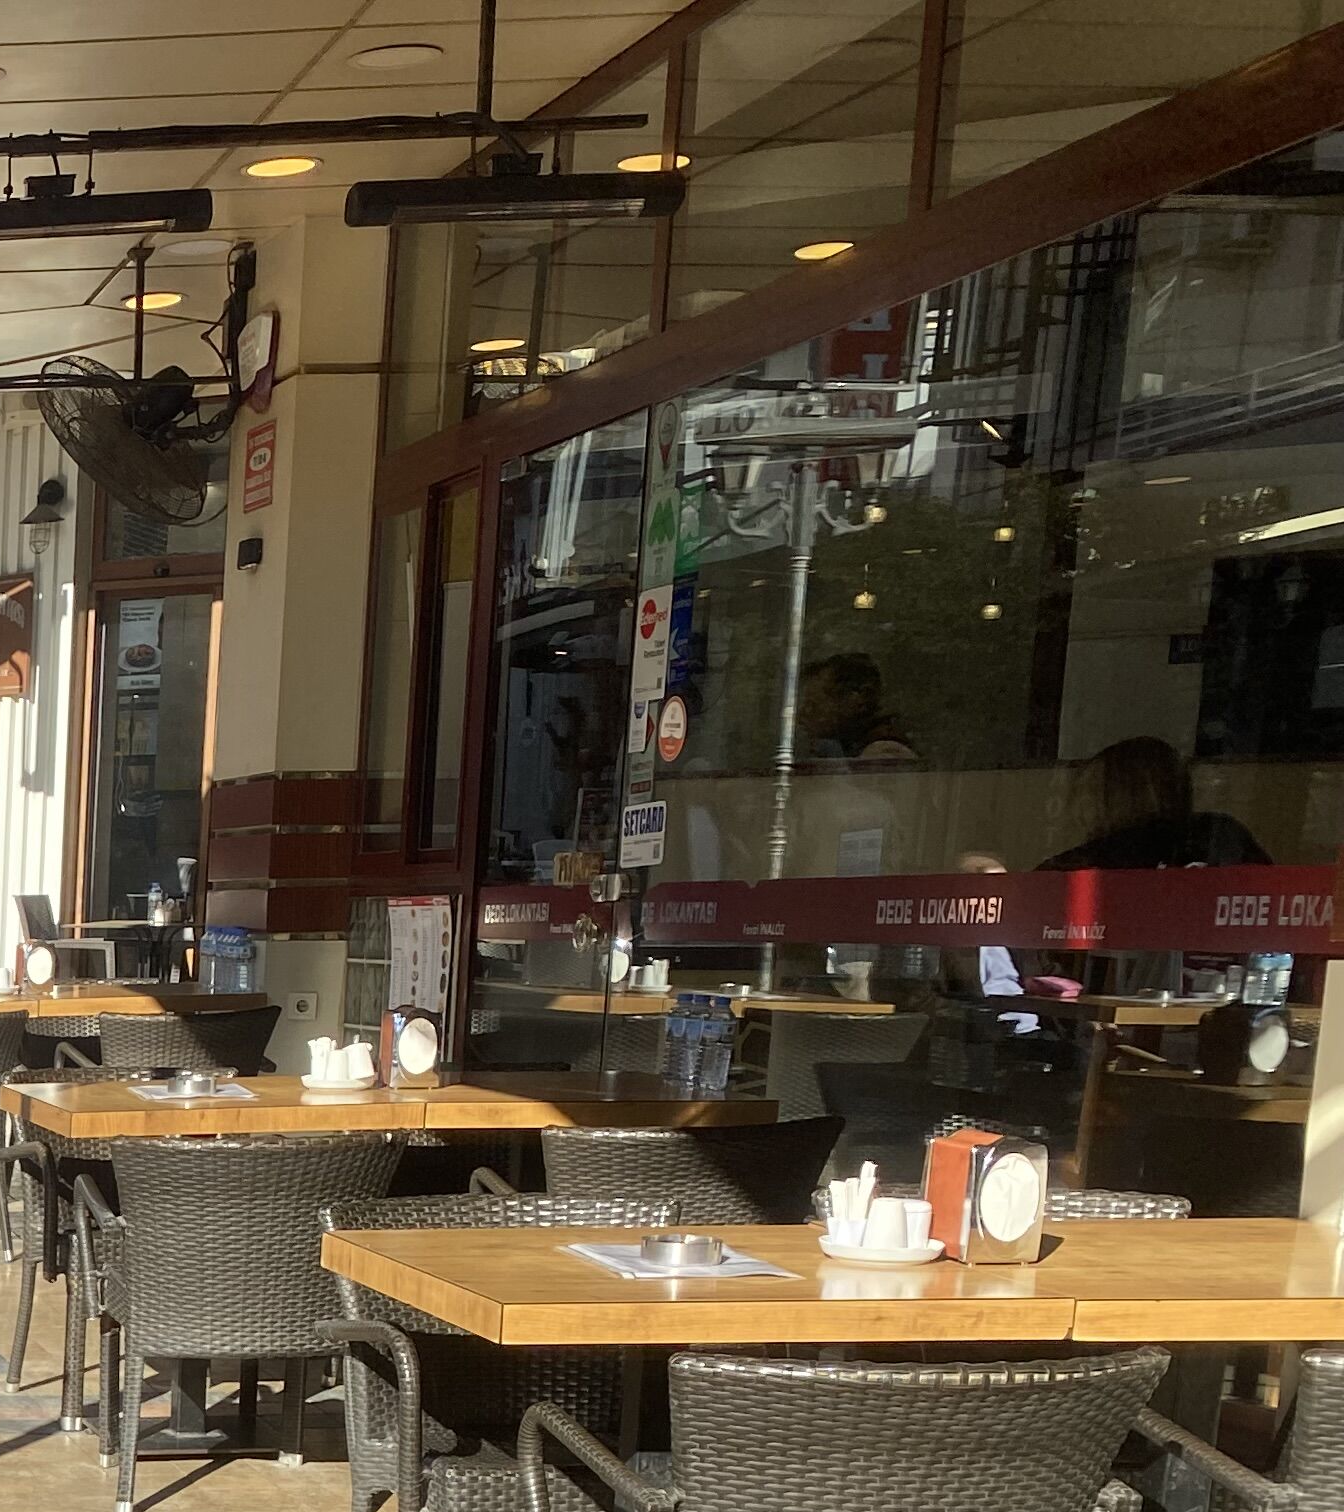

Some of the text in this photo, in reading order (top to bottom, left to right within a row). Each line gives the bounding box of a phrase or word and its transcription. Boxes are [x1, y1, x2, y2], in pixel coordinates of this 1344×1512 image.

[624, 805, 664, 838] SETCARD
[876, 897, 1003, 925] DEDE LOKANTASI
[1215, 895, 1270, 926] DEDE
